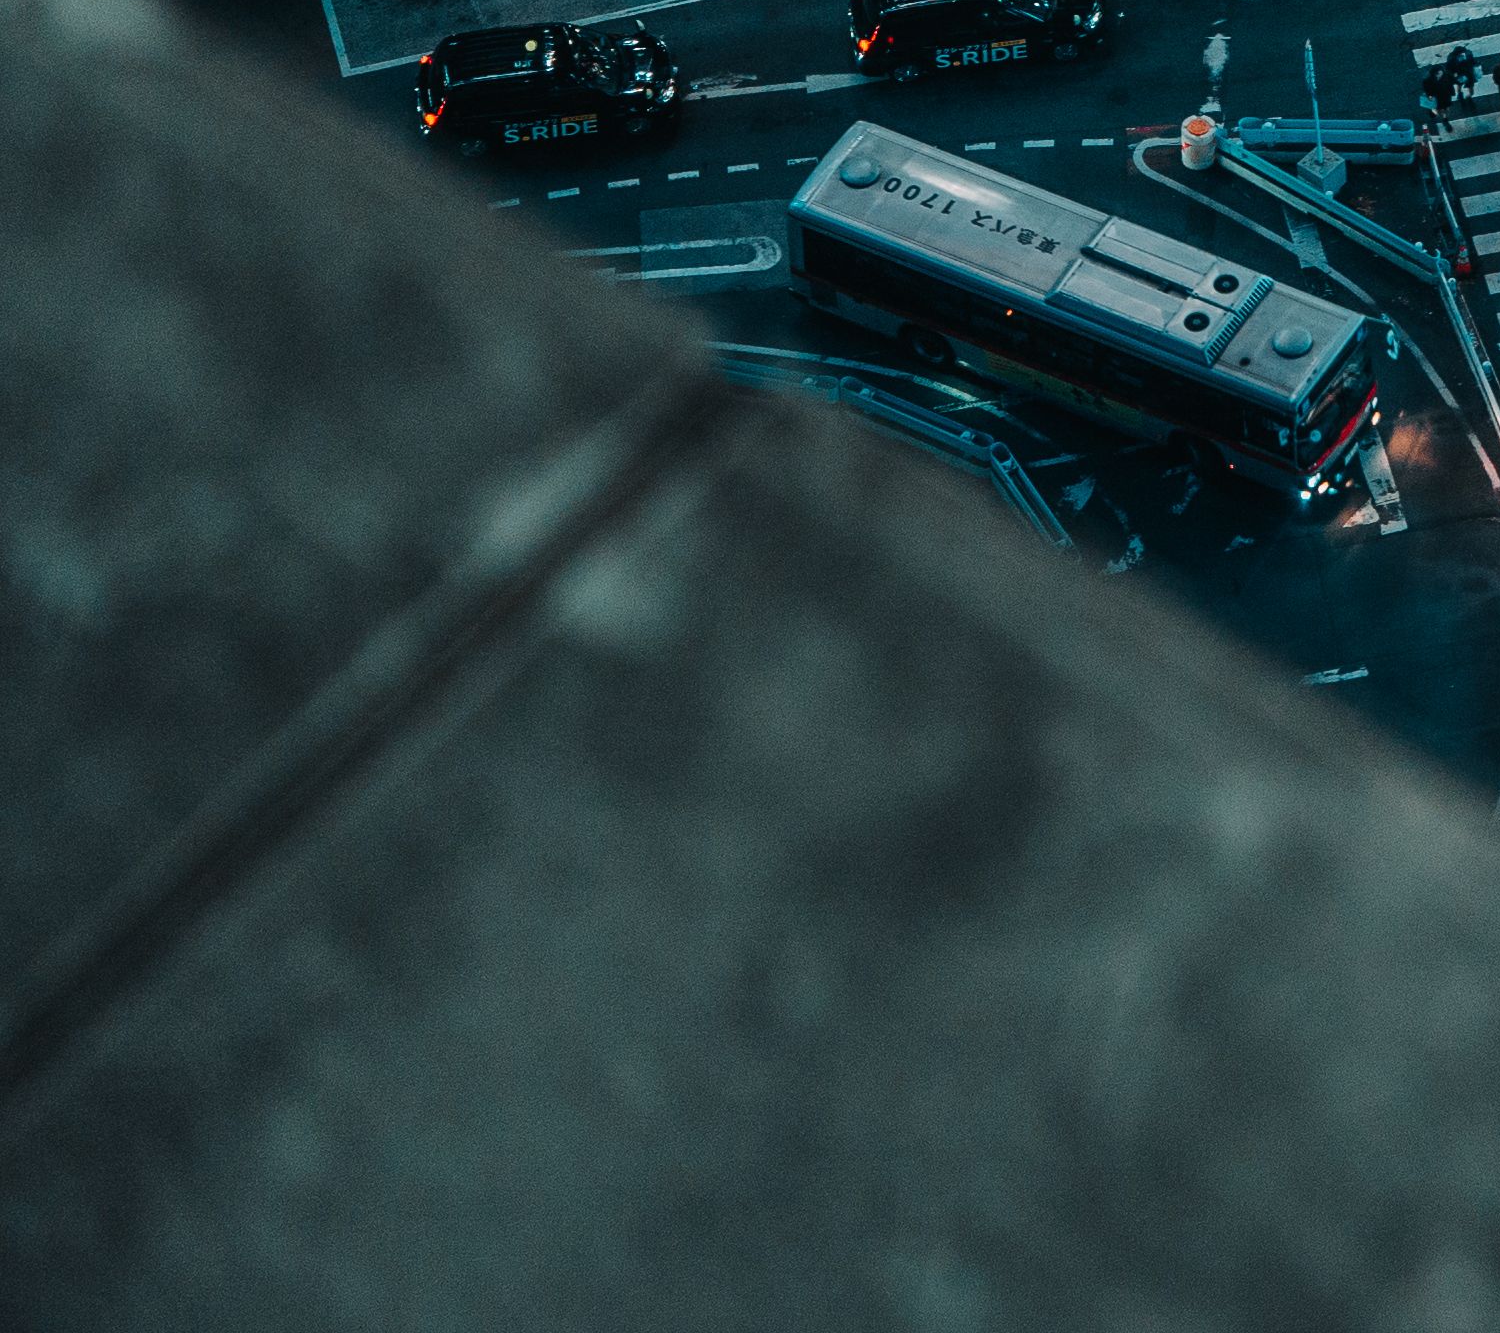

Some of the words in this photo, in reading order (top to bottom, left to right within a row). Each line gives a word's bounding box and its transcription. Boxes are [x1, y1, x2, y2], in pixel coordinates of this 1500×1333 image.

[935, 44, 1029, 69] S.RIDE
[504, 118, 599, 143] S.RIDE
[882, 172, 955, 220] 1700
[973, 206, 1064, 259] 東急バス
